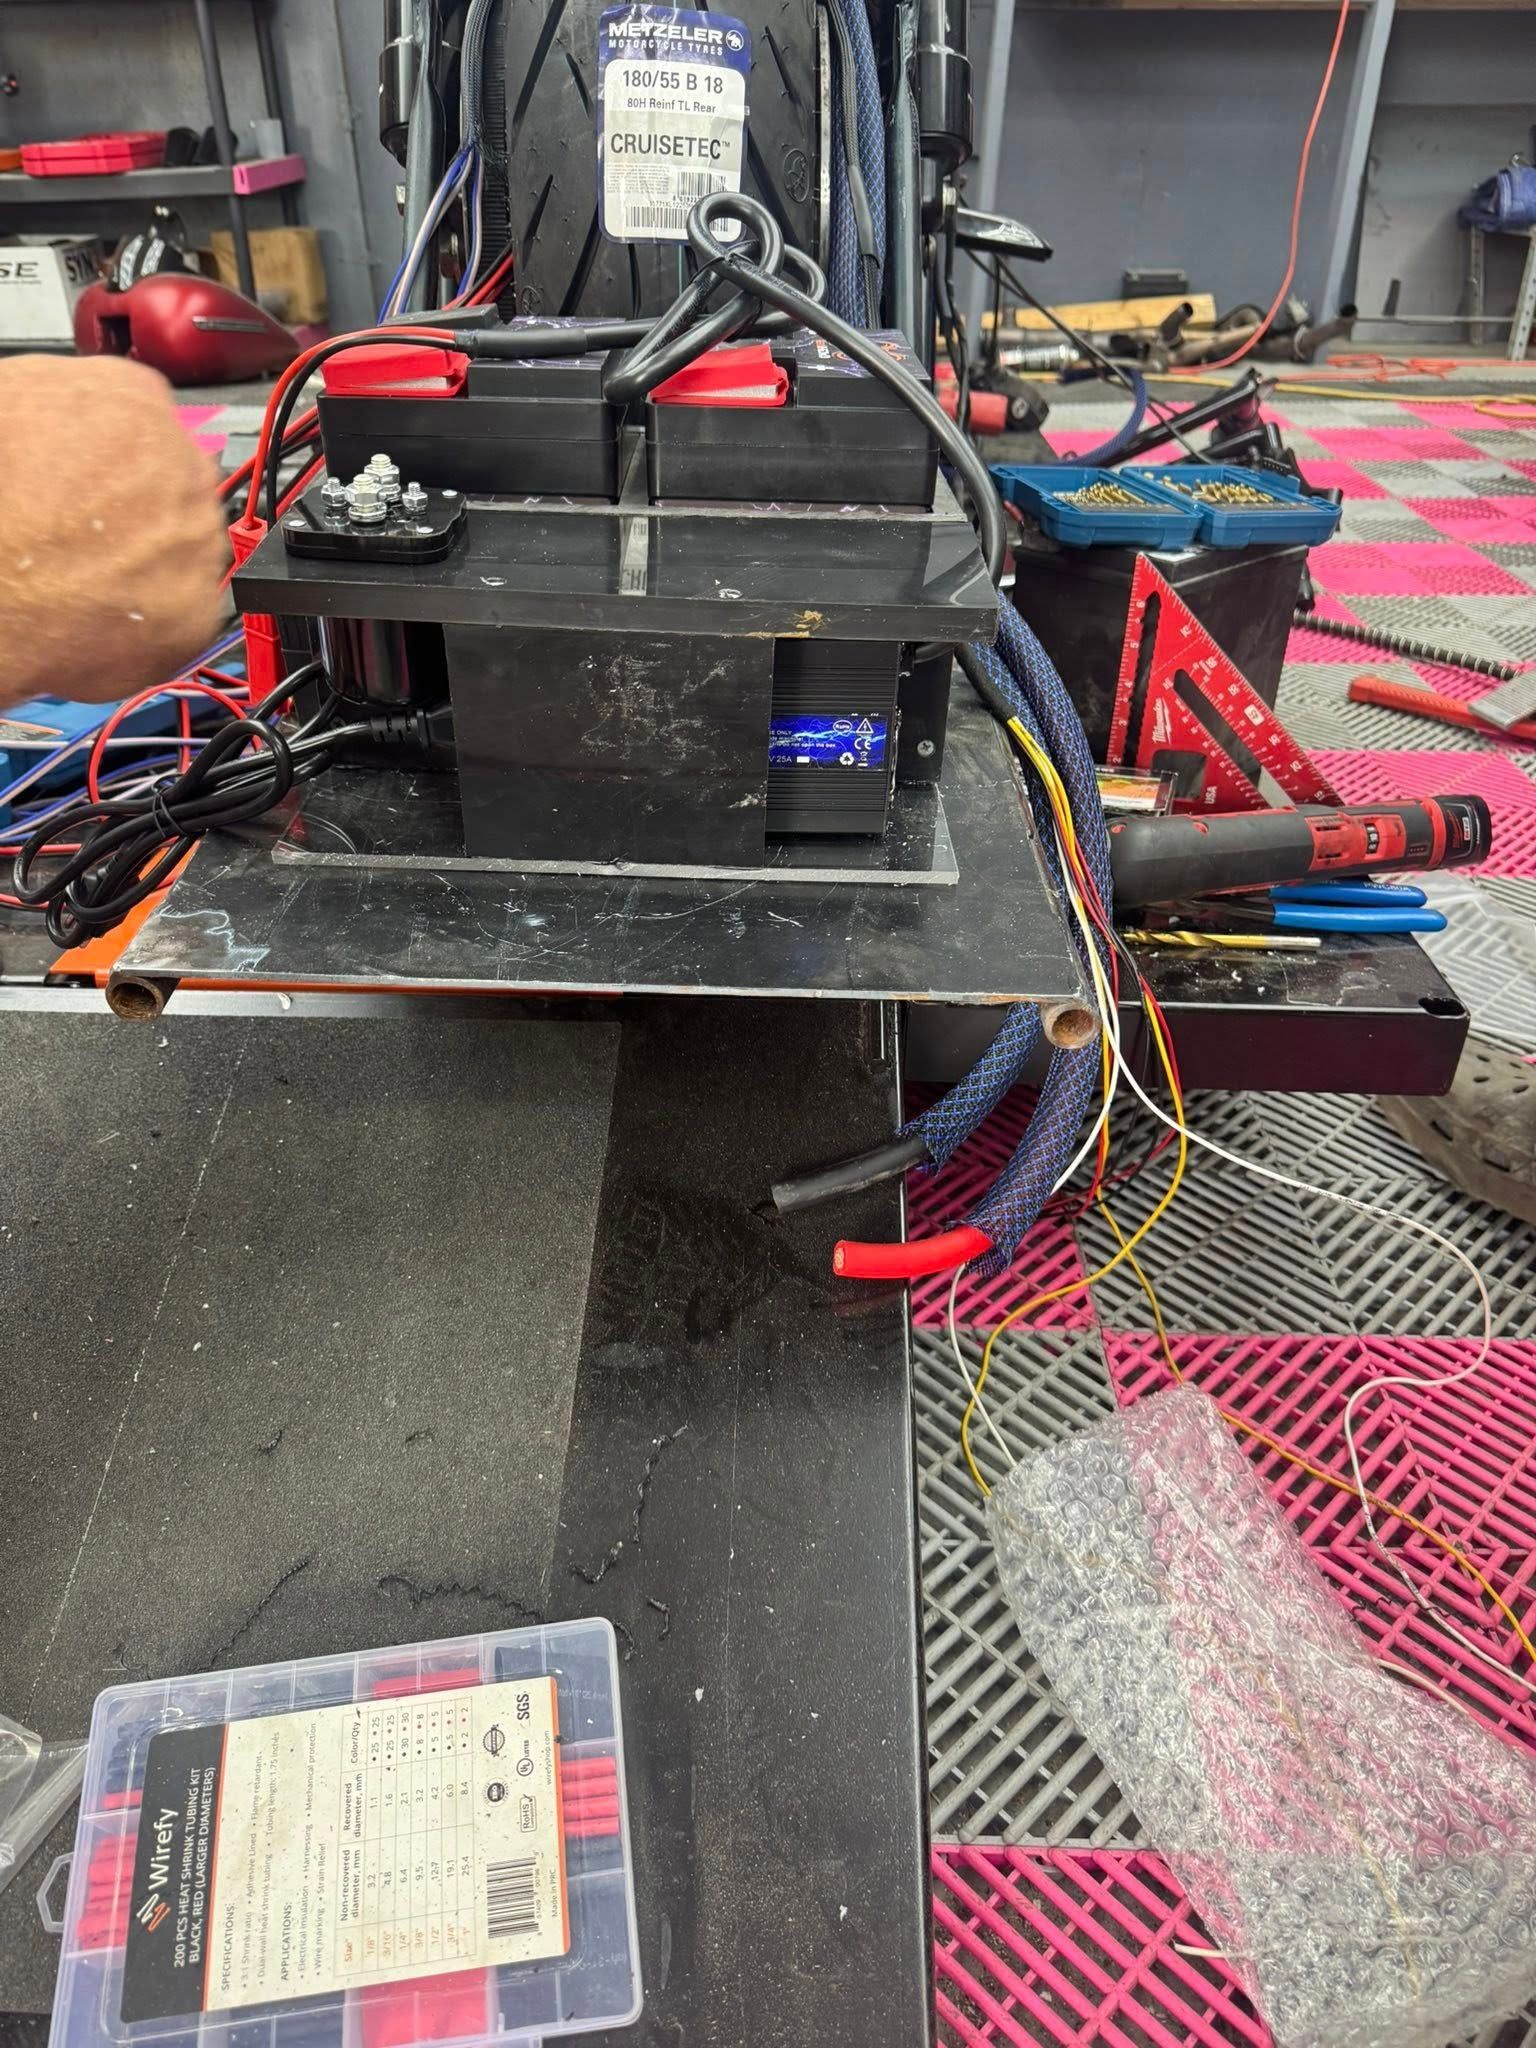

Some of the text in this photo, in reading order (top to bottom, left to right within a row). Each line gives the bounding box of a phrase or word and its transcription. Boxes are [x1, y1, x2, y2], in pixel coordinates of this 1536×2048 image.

[608, 22, 723, 45] METZELER
[608, 38, 723, 56] MOTORCYCLE TYRES
[622, 70, 723, 94] 180/55 B 18
[627, 97, 716, 114] 80H Reinf TL Rear
[1129, 641, 1140, 650] 5
[1124, 680, 1134, 689] 4
[1118, 719, 1128, 727] 3
[776, 755, 792, 763] 25A
[1112, 756, 1123, 764] 2
[1204, 785, 1218, 804] USA
[516, 1692, 529, 1721] SGS
[372, 1716, 380, 1728] 25
[386, 1714, 394, 1725] 25
[401, 1711, 409, 1723] 30
[270, 1731, 279, 1757] inches
[350, 1721, 360, 1764] Color/Qty
[371, 1741, 379, 1753] 25
[386, 1739, 394, 1751] 25
[401, 1737, 409, 1749] 30
[269, 1758, 277, 1775] 1.75
[543, 1729, 552, 1784] wirefyshop.com
[353, 1772, 362, 1838] diameter, mm
[369, 1796, 378, 1809] 1.1
[400, 1791, 408, 1805] 2.1
[415, 1787, 423, 1803] 3.2
[343, 1781, 352, 1831] Recovered
[522, 1802, 531, 1829] RoHS
[265, 1806, 275, 1836] Tubing
[146, 1805, 180, 1890] Wirefy
[297, 1722, 317, 1972] Electrical insulation Harnessing Mechanical protection
[172, 1766, 200, 1968] 200 PCS HEAT SHRINK TUBING KIT
[187, 1766, 216, 1963] BLACK, RED (LARGER DIAMETERS)
[240, 1754, 262, 1981] 3:1 Shrink ratio Adhesive Lined Flame retardant
[262, 1853, 272, 1882] tubing
[415, 1865, 423, 1881] 9.5
[431, 1860, 439, 1880] 12.7
[446, 1858, 454, 1878] 19.1
[461, 1855, 469, 1876] 25.4
[339, 1848, 350, 1921] Non-recovered
[351, 1848, 360, 1918] diameter, mm
[367, 1873, 375, 1888] 3.2
[384, 1870, 392, 1886] 4.8
[399, 1868, 407, 1883] 6.4
[260, 1883, 269, 1910] shrink
[550, 1885, 556, 1894] in
[313, 1842, 326, 1969] Wire marking Strain Relief
[259, 1912, 268, 1933] heat
[219, 1901, 235, 1991] SPECIFICATIONS:
[279, 1900, 292, 1981] APPLICATIONS:
[256, 1934, 267, 1978] Dual-wall
